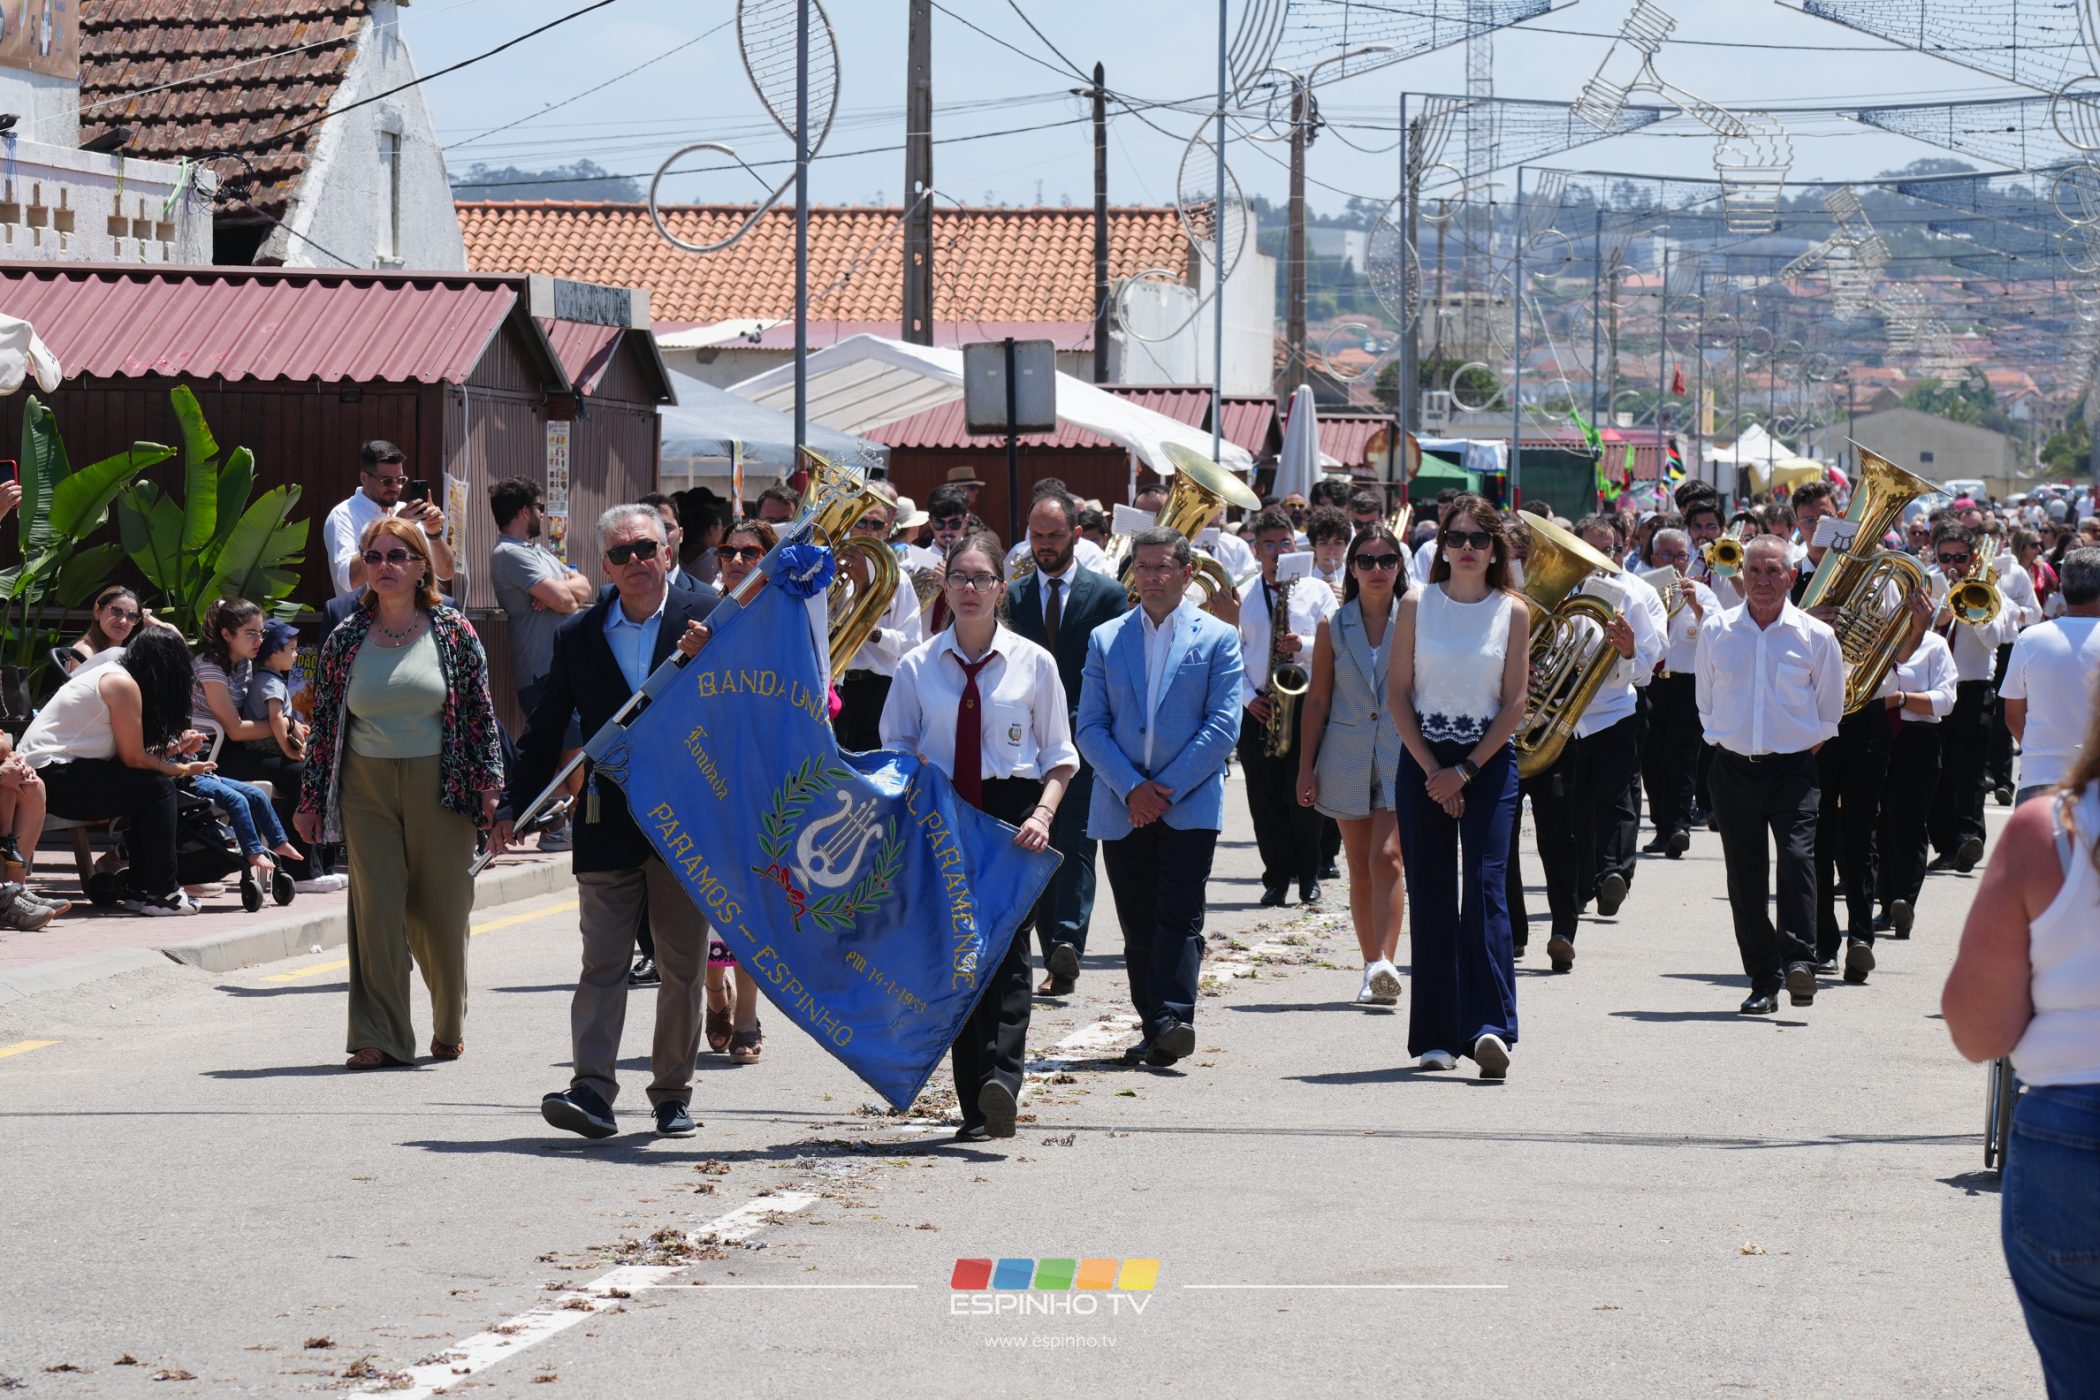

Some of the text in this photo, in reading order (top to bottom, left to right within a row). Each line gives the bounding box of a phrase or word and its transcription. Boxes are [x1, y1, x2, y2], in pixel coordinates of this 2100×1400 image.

[646, 802, 743, 924] PARAMOS
[751, 944, 854, 1047] ESPINHO
[918, 810, 978, 991] PARAMENSE
